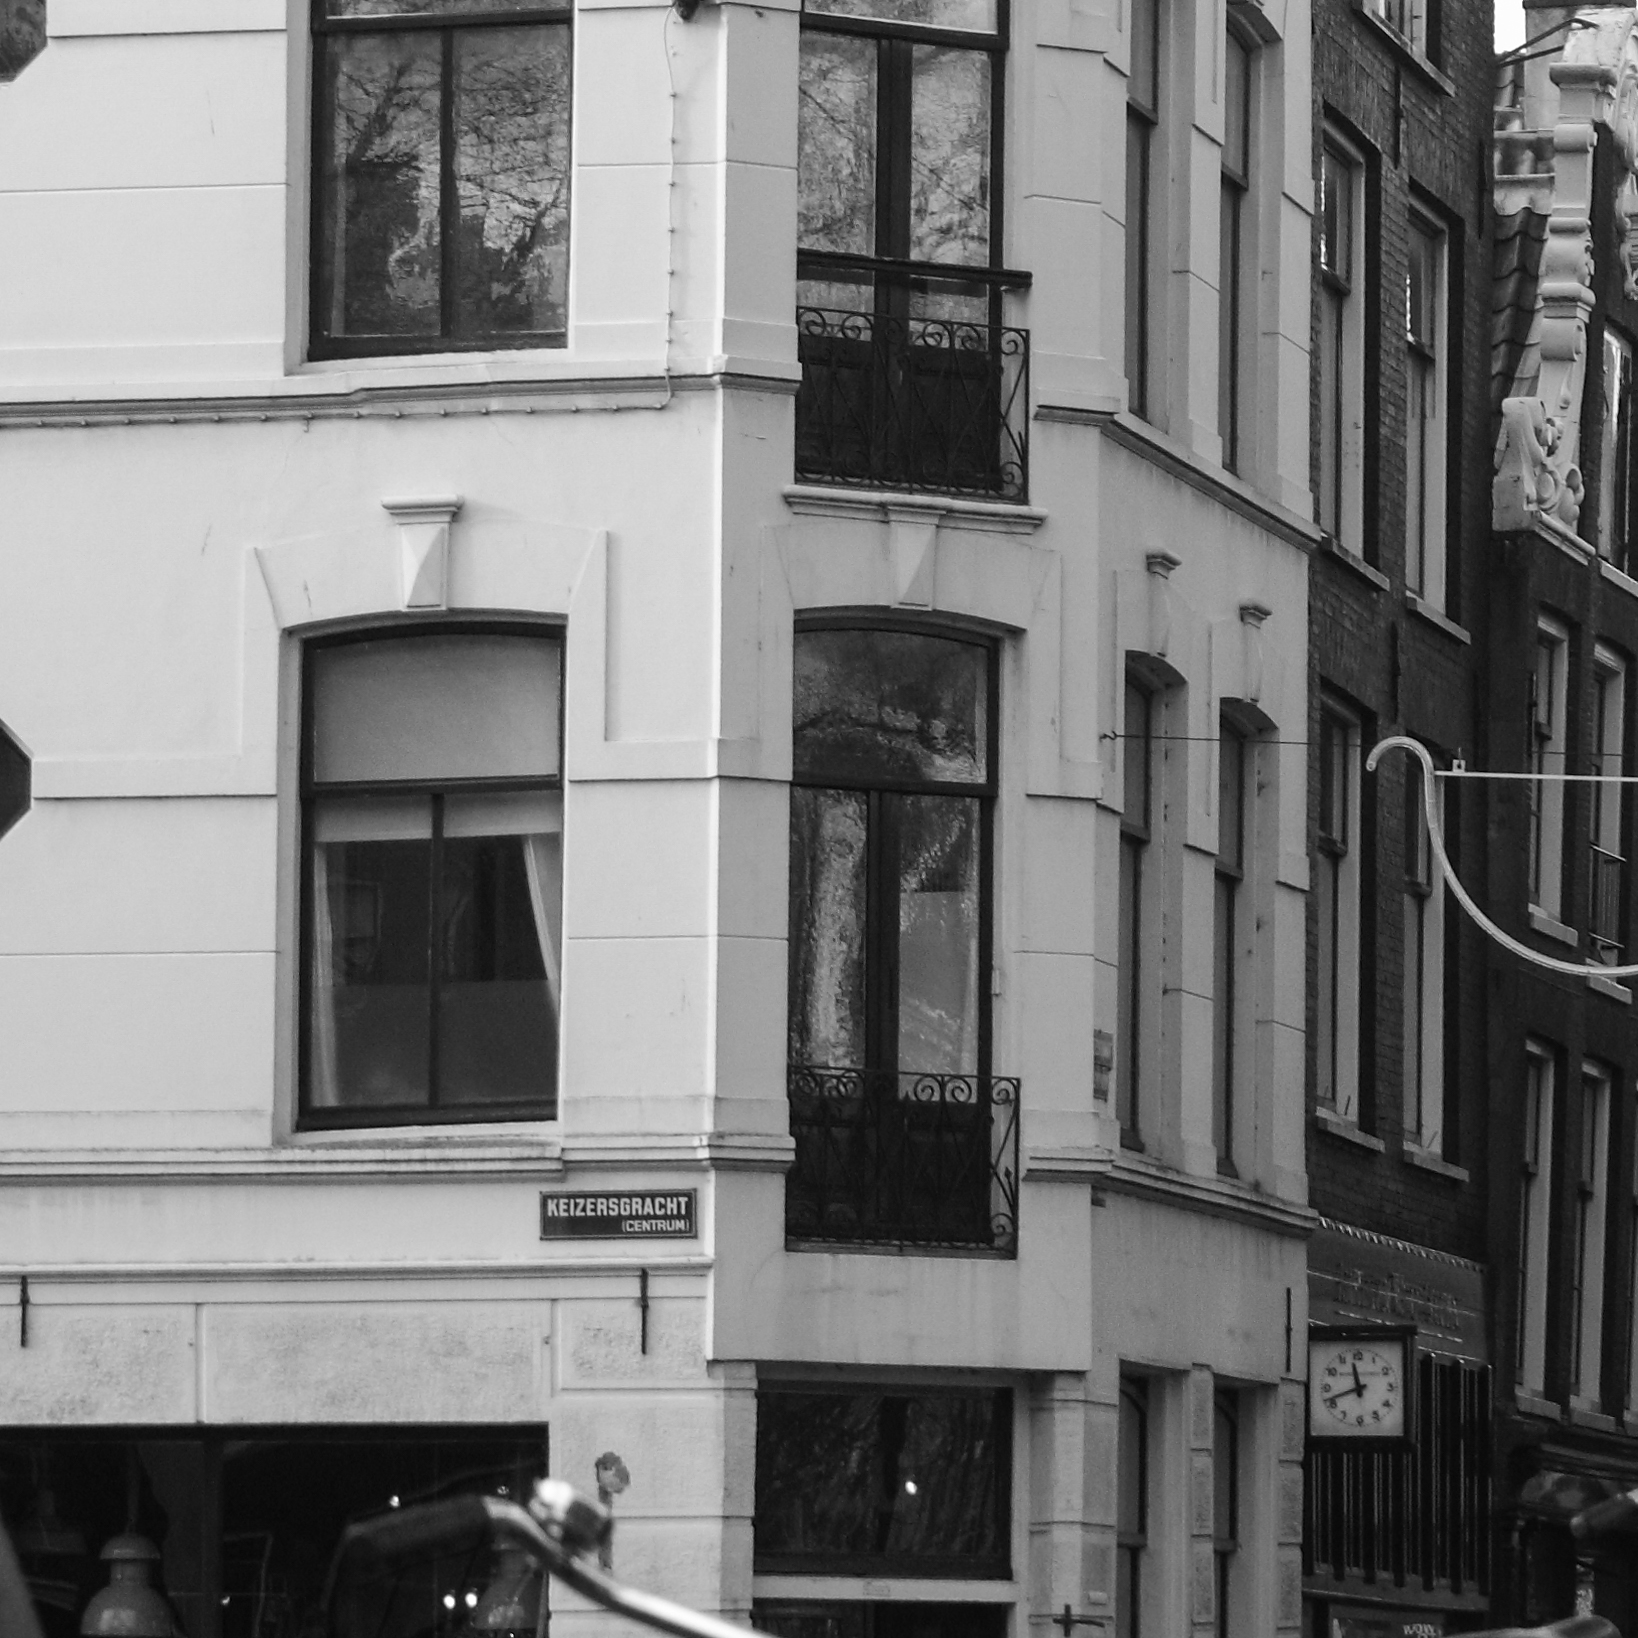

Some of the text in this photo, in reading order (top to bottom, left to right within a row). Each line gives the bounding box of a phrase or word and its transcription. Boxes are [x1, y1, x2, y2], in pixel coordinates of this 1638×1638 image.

[547, 1196, 689, 1217] KEIZERSGRACHT
[621, 1219, 690, 1232] (CENTRUM)
[1371, 1356, 1377, 1364] 1
[1381, 1366, 1389, 1375] 2
[1387, 1382, 1394, 1392] 3
[1382, 1399, 1391, 1408] 4
[1340, 1410, 1347, 1420] 7
[1372, 1410, 1380, 1421] 5
[1356, 1415, 1364, 1427] 6
